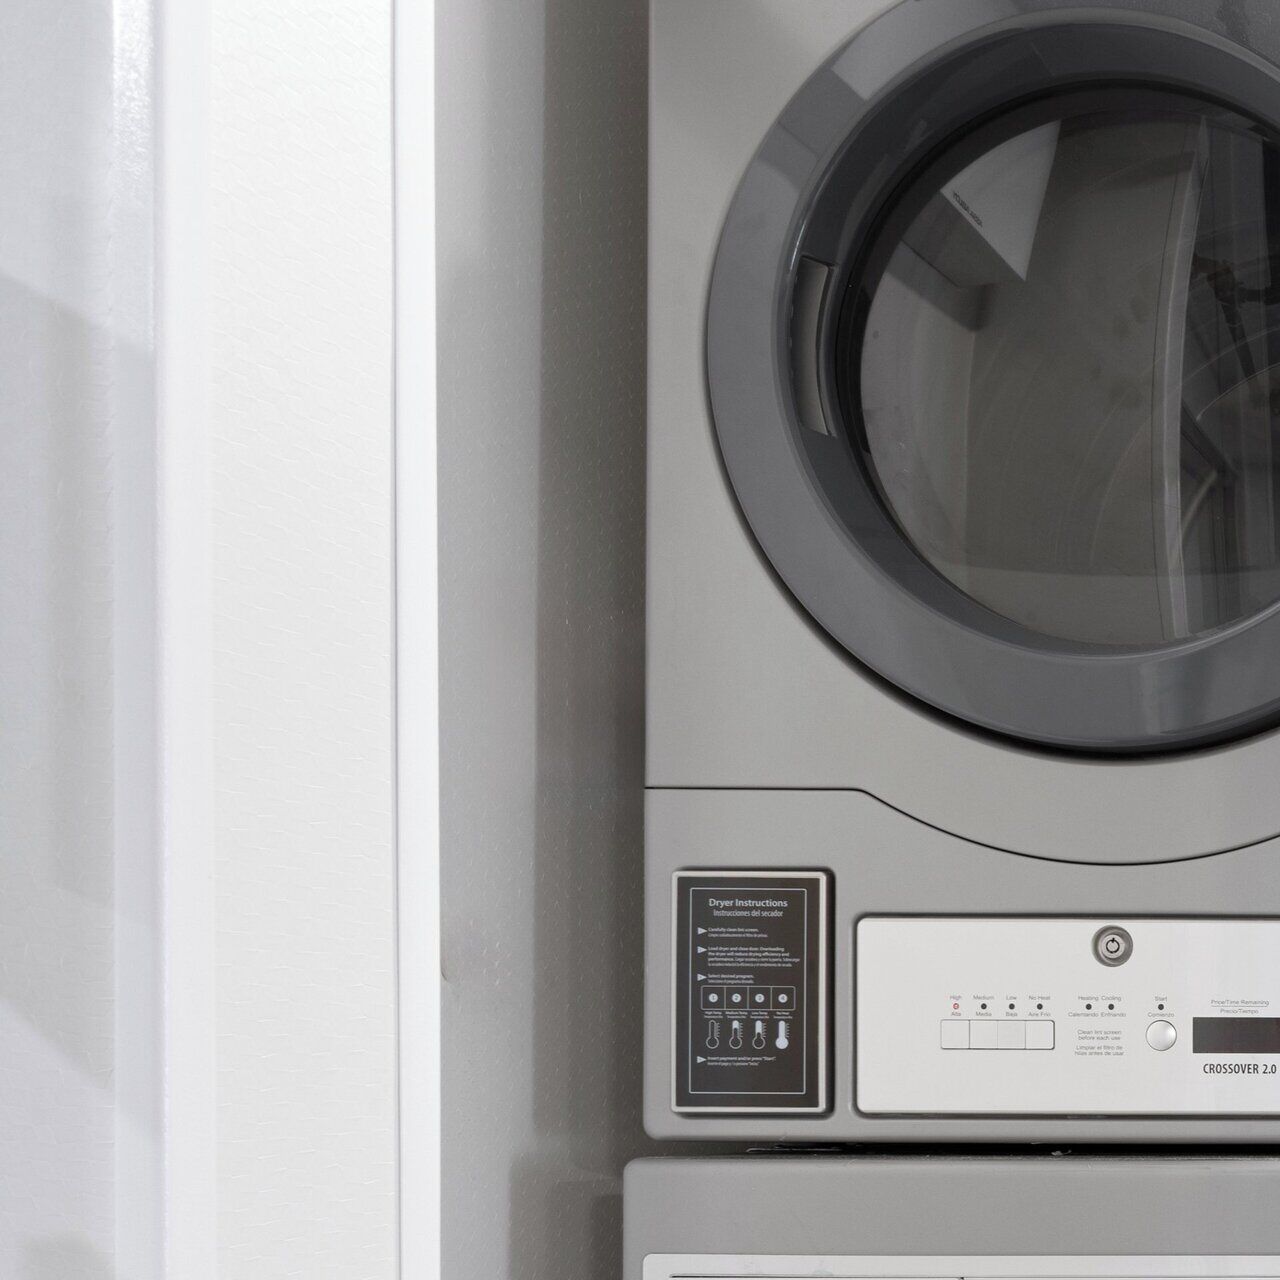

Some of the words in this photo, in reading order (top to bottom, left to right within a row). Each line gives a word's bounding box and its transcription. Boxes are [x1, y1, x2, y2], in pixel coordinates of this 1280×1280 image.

[709, 899, 734, 908] Dryer
[735, 899, 788, 907] Instructions
[1203, 1064, 1259, 1074] CROSSOVER
[1262, 1064, 1277, 1074] 2.0
